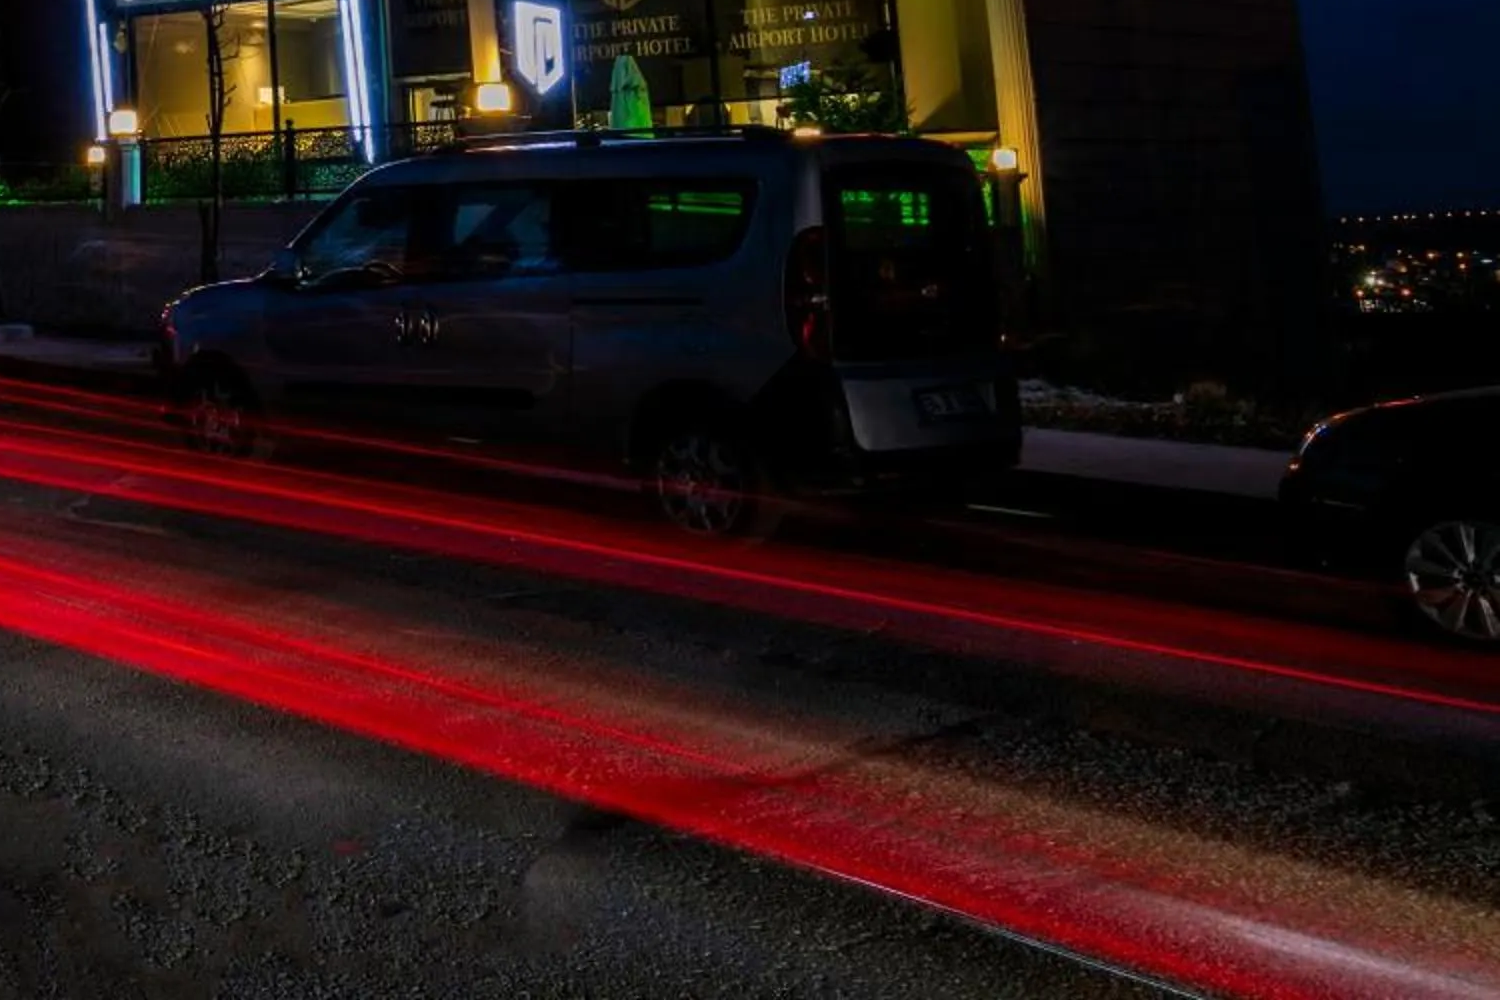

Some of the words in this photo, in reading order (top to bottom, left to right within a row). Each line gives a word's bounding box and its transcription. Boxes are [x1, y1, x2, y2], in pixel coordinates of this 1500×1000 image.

[611, 14, 681, 37] PRIVATE
[740, 6, 779, 25] THE
[635, 36, 696, 57] HOTEL
[729, 26, 806, 50] AIRPORT
